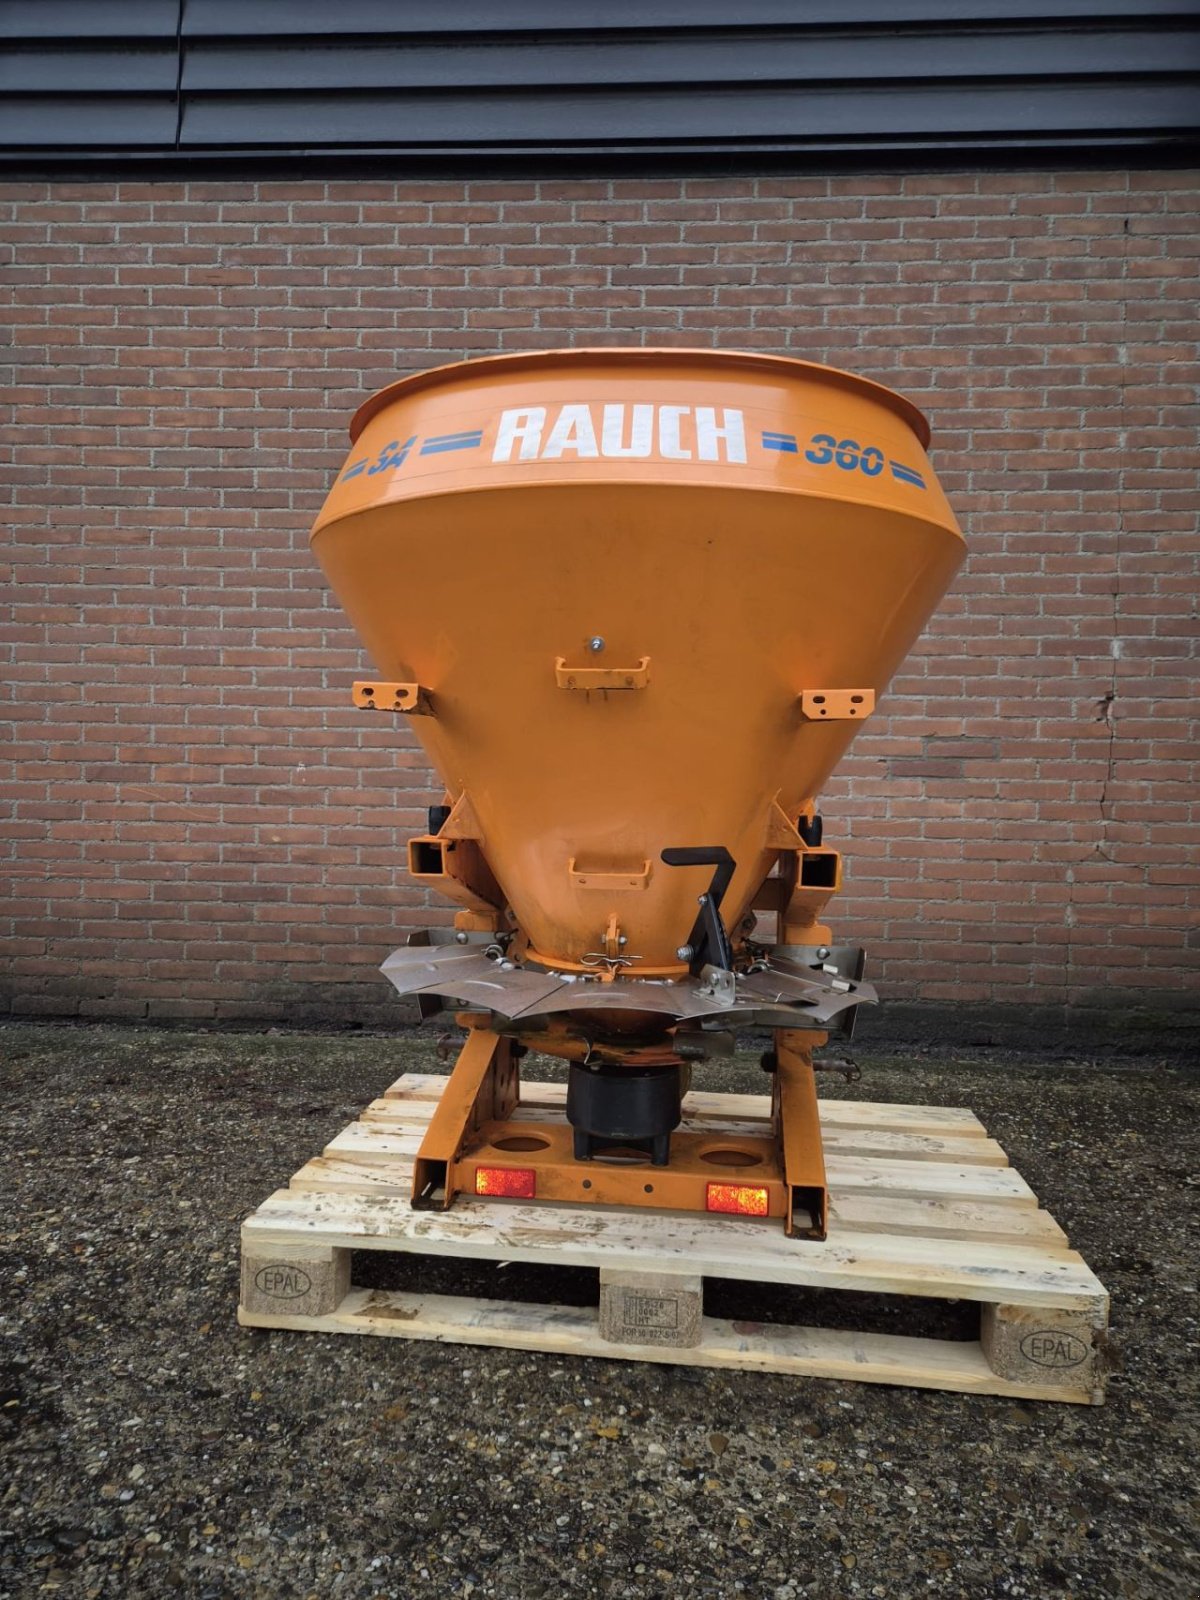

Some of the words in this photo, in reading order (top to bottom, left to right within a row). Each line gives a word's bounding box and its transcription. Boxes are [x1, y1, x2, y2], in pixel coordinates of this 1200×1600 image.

[367, 434, 418, 476] SA
[492, 404, 748, 464] RAUCH
[805, 433, 885, 477] 360
[264, 1272, 303, 1293] EPAL
[1031, 1338, 1078, 1361] EPAL
